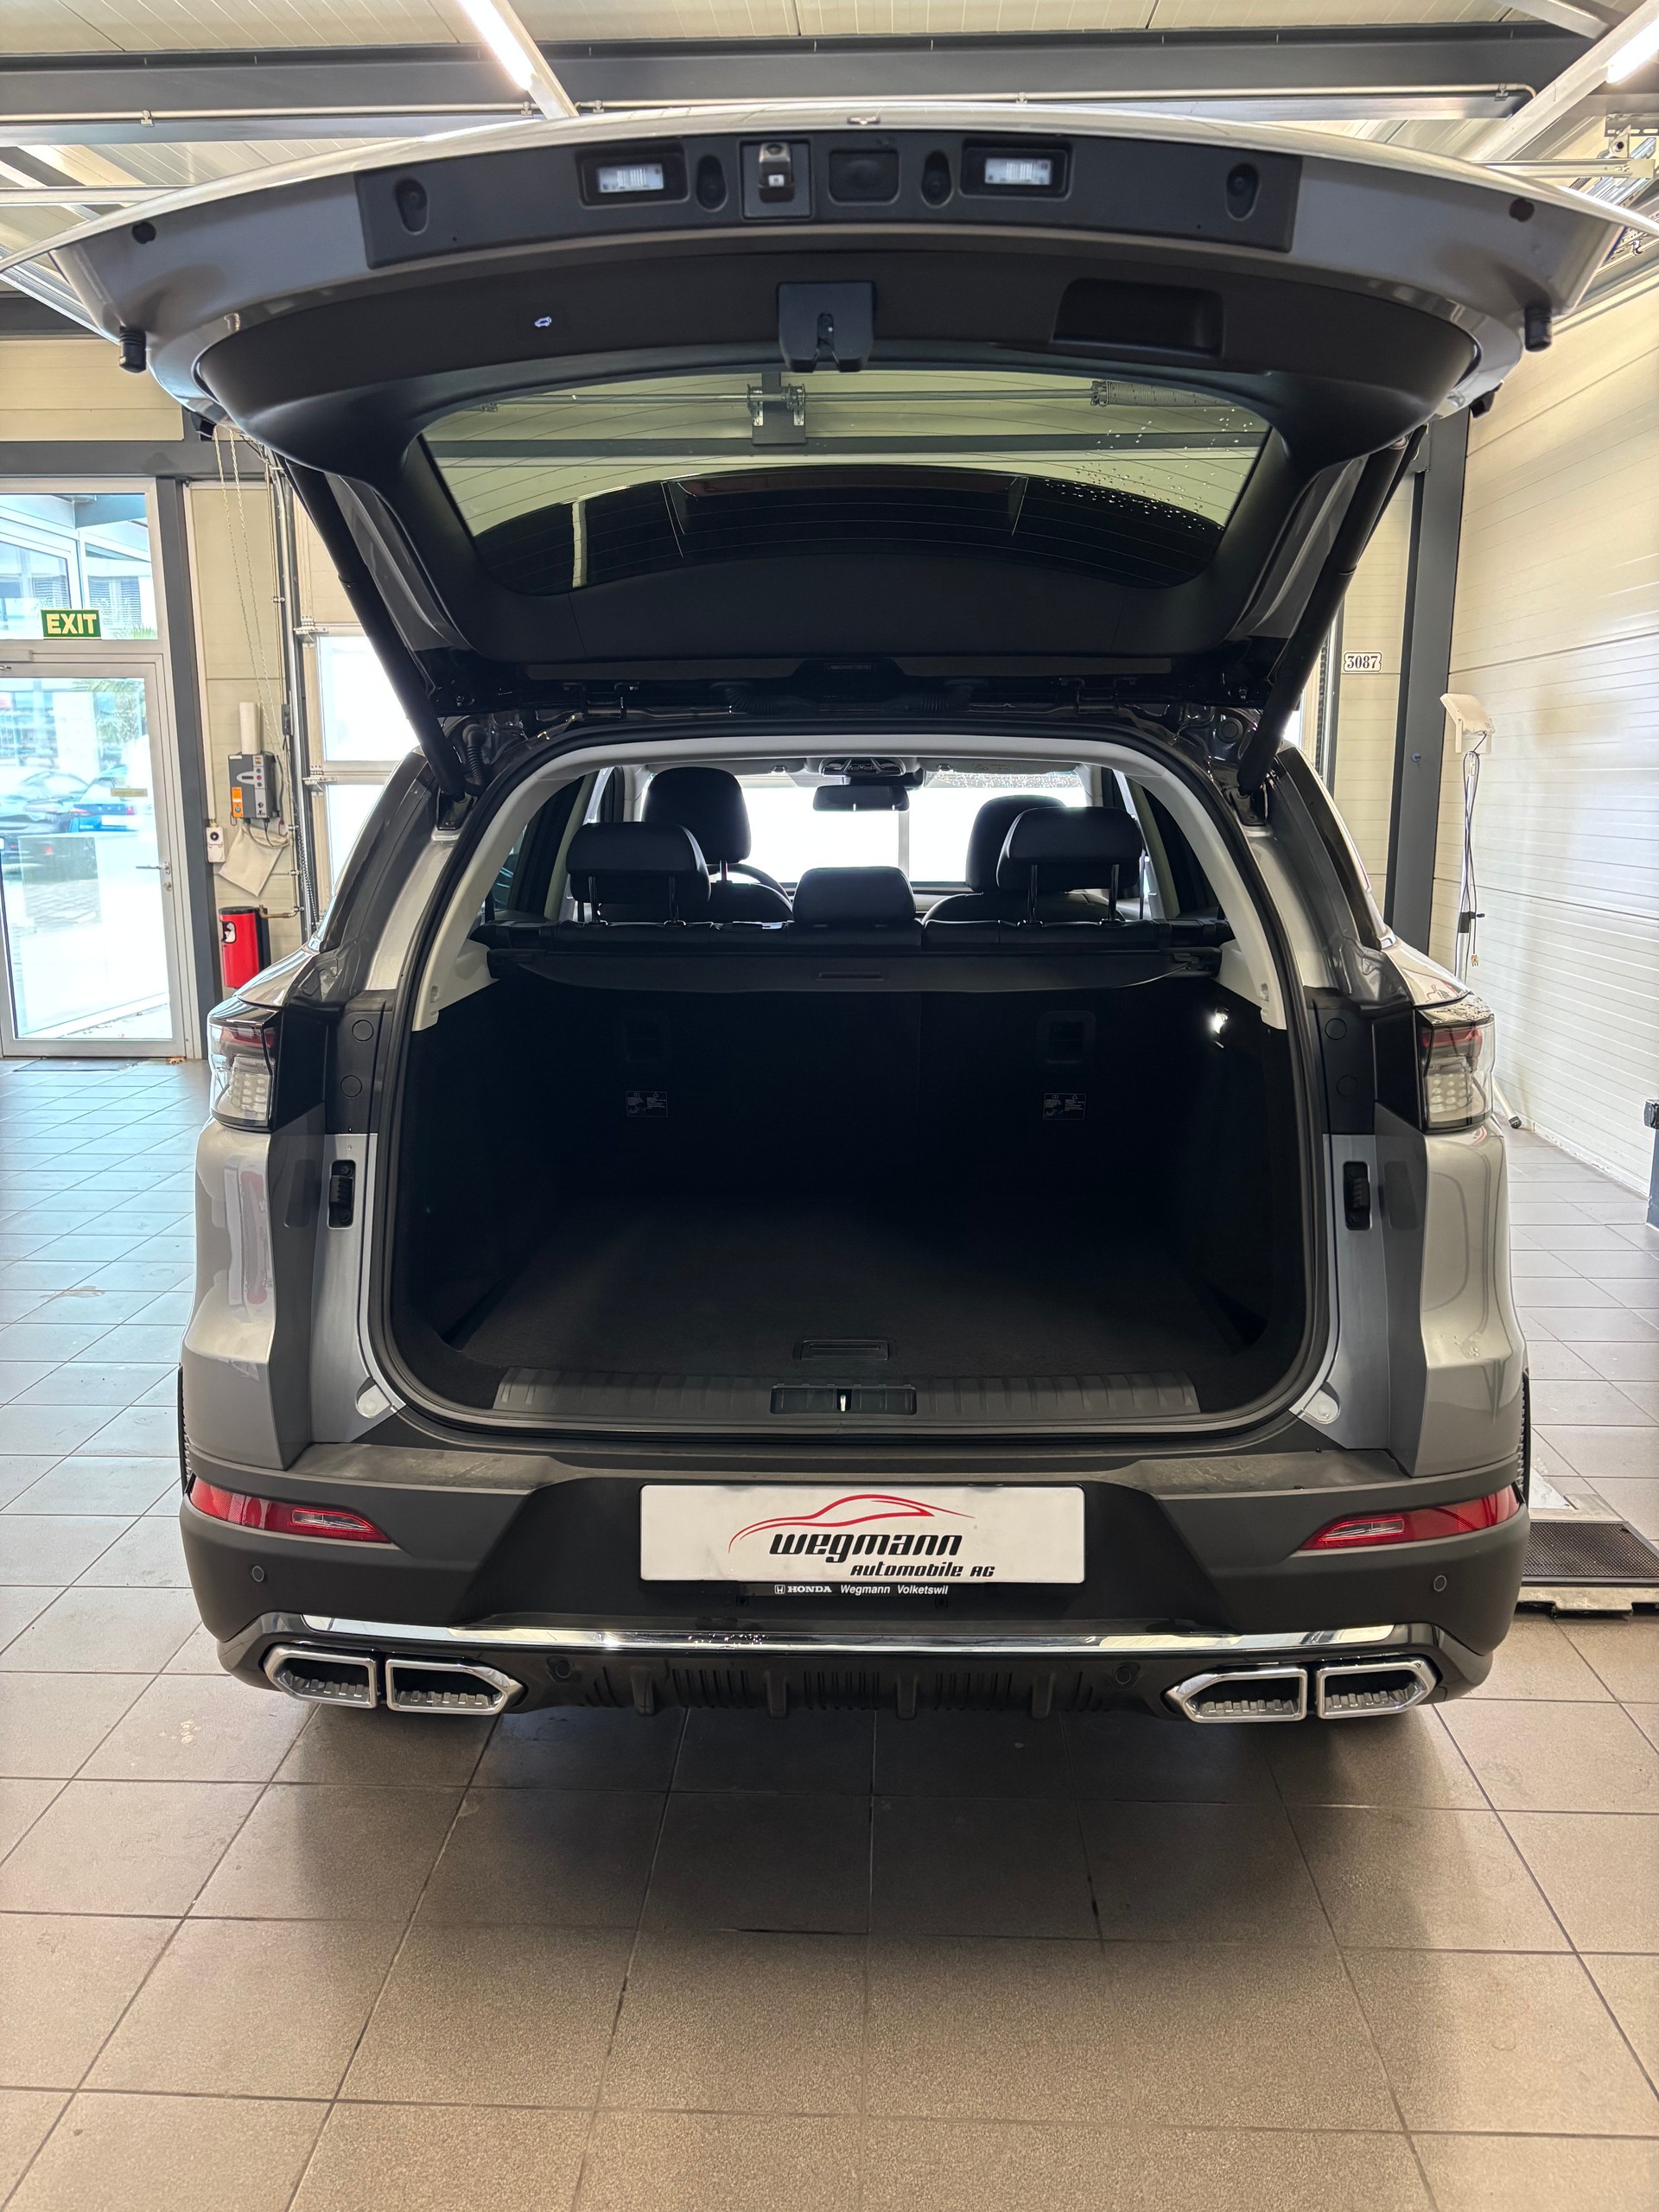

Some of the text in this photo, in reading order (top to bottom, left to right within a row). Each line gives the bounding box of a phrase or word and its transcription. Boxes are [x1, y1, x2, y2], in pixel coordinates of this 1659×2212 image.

[46, 613, 97, 634] EXIT
[1347, 655, 1378, 669] 3087
[769, 1534, 963, 1563] wegmann
[969, 1566, 995, 1577] AG
[840, 1584, 891, 1596] Wegmann
[897, 1584, 949, 1595] Volketswil
